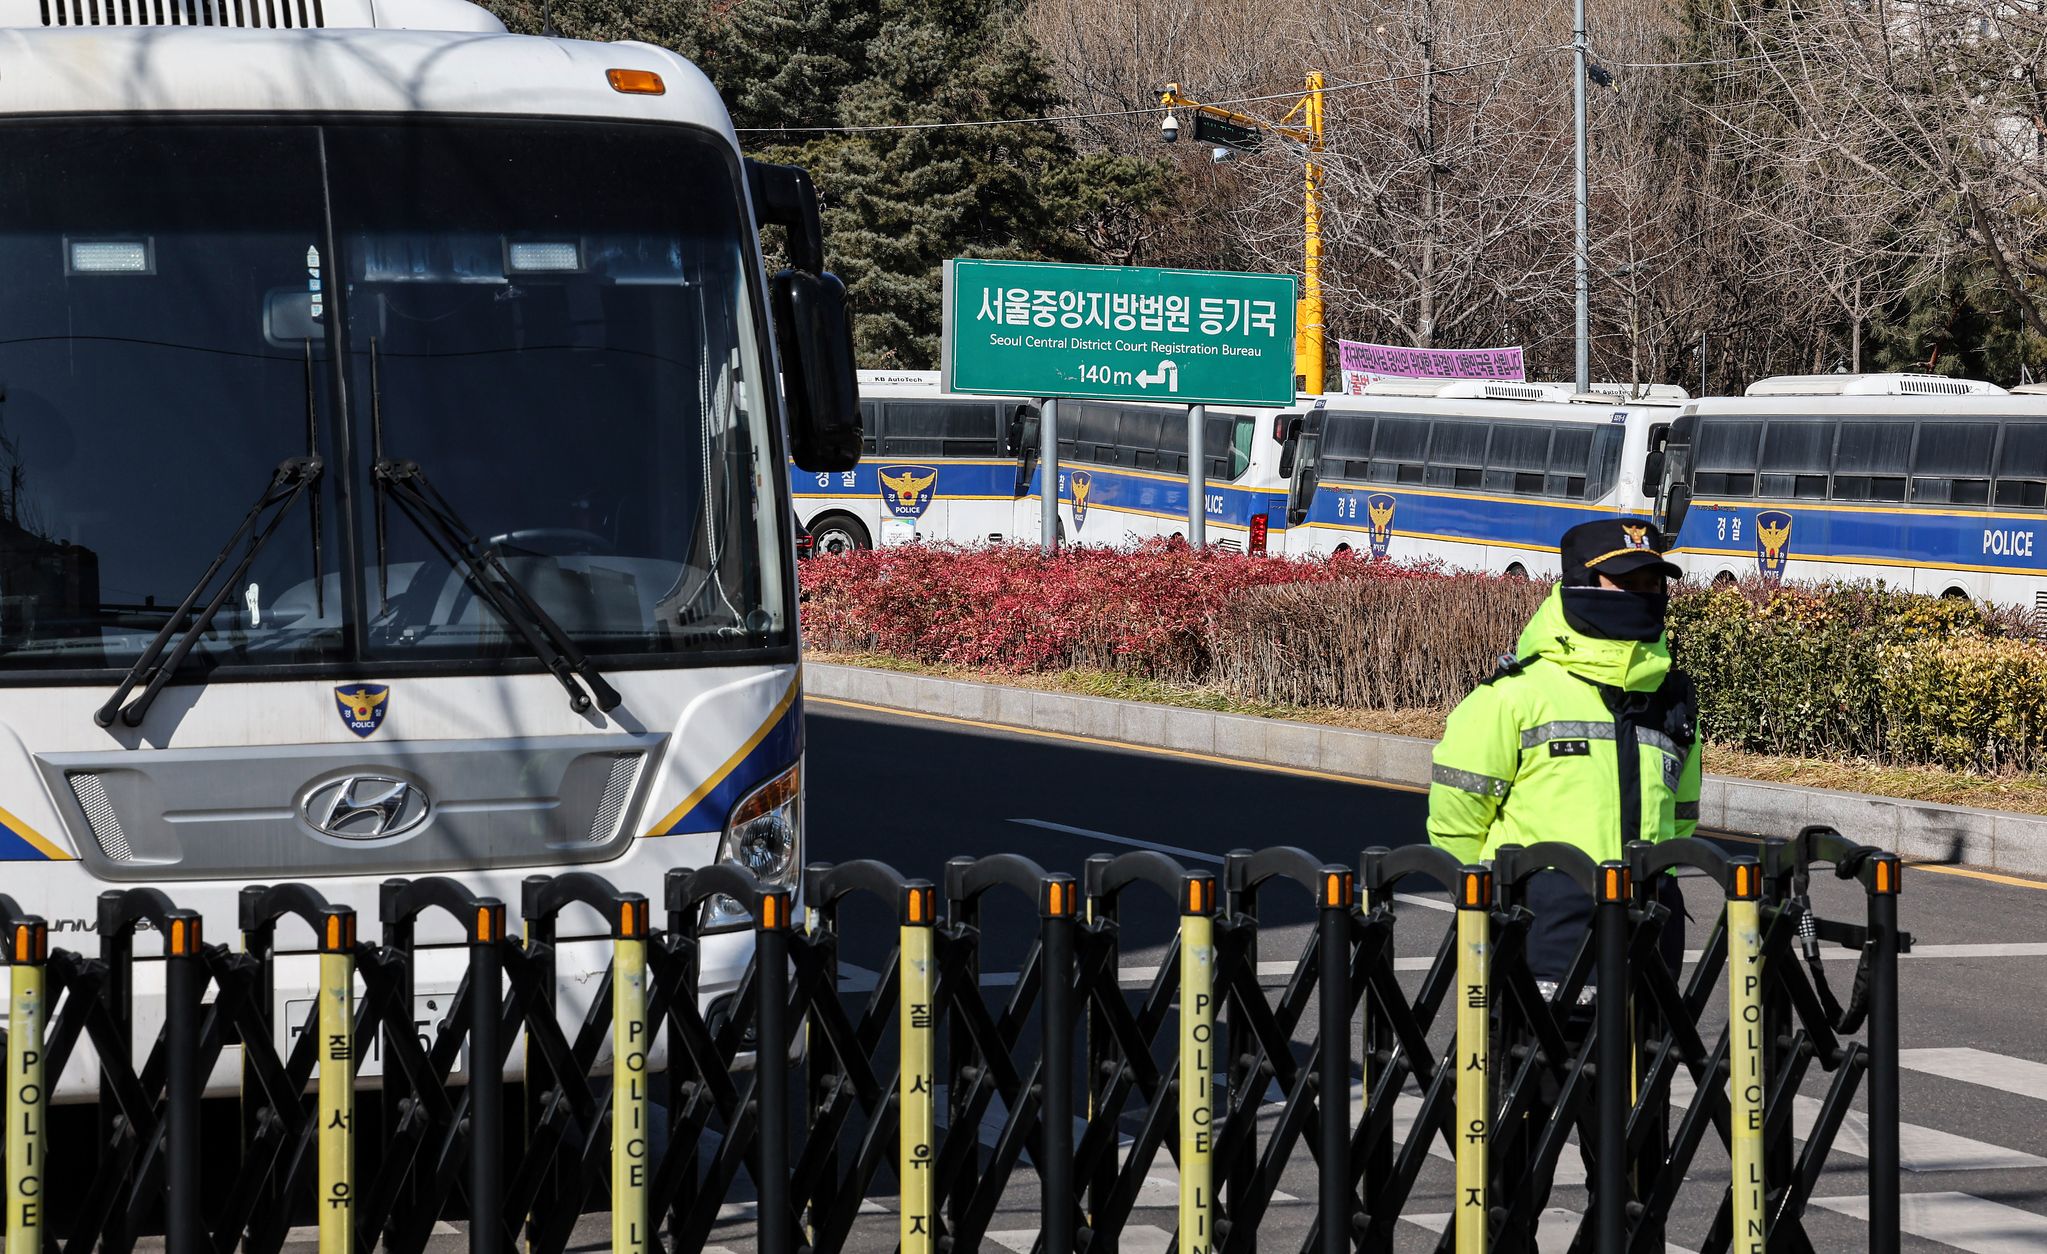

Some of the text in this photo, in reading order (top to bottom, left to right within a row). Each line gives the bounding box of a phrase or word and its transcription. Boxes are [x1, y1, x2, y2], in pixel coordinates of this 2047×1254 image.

[976, 287, 1277, 337] 서울중앙지방법원 등기국
[989, 333, 1262, 357] Seoul Central District Court Registration Bureau
[1455, 353, 1495, 377] 대한민국을
[895, 506, 921, 514] POLICE
[1982, 529, 2034, 557] POLICE
[626, 1020, 646, 1188] POLICE
[1192, 993, 1211, 1153] POLICE
[1465, 983, 1489, 1212] 질서유지
[1743, 975, 1762, 1131] POLICE
[19, 1051, 40, 1228] POLICE
